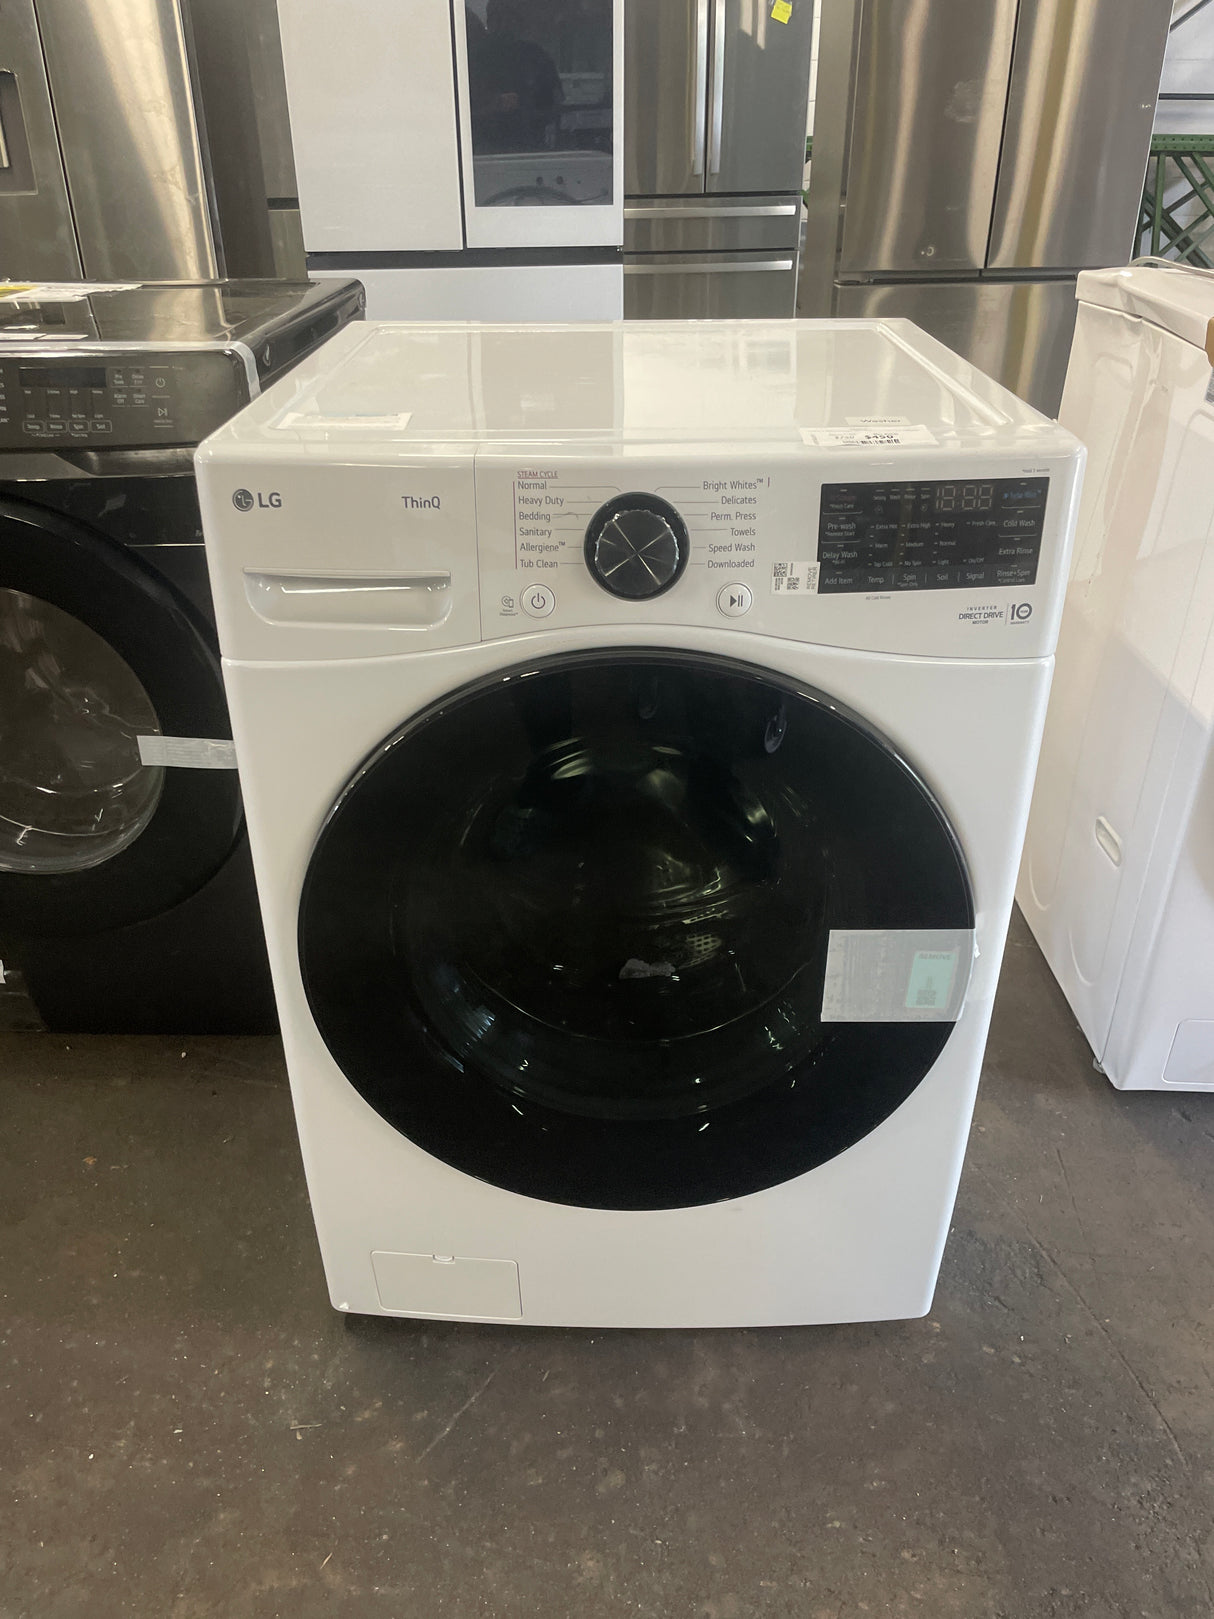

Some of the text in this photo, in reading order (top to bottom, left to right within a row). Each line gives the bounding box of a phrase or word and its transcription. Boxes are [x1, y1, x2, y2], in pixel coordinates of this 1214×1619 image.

[518, 481, 547, 490] Normal
[703, 481, 727, 492] Bright
[257, 492, 282, 508] LG
[401, 496, 441, 510] ThinQ
[518, 496, 564, 507] Heavy Duty
[721, 496, 757, 505] Delicates
[519, 512, 551, 522] Bedding
[710, 512, 757, 521] Perm. Press
[827, 522, 856, 530] Pre-wash
[519, 527, 552, 538] Sanitary
[731, 527, 756, 536] Towels
[708, 543, 756, 554] Speed Wash
[822, 551, 857, 560] Delay Wash
[520, 559, 558, 568] Tub Clean
[707, 560, 755, 569] Downloaded
[868, 576, 884, 584] Temp
[903, 574, 916, 582] Spin
[936, 573, 948, 581] Soil
[966, 572, 985, 581] Signal
[958, 611, 1004, 620] DIRECT DRIVE
[1010, 602, 1033, 621] 10
